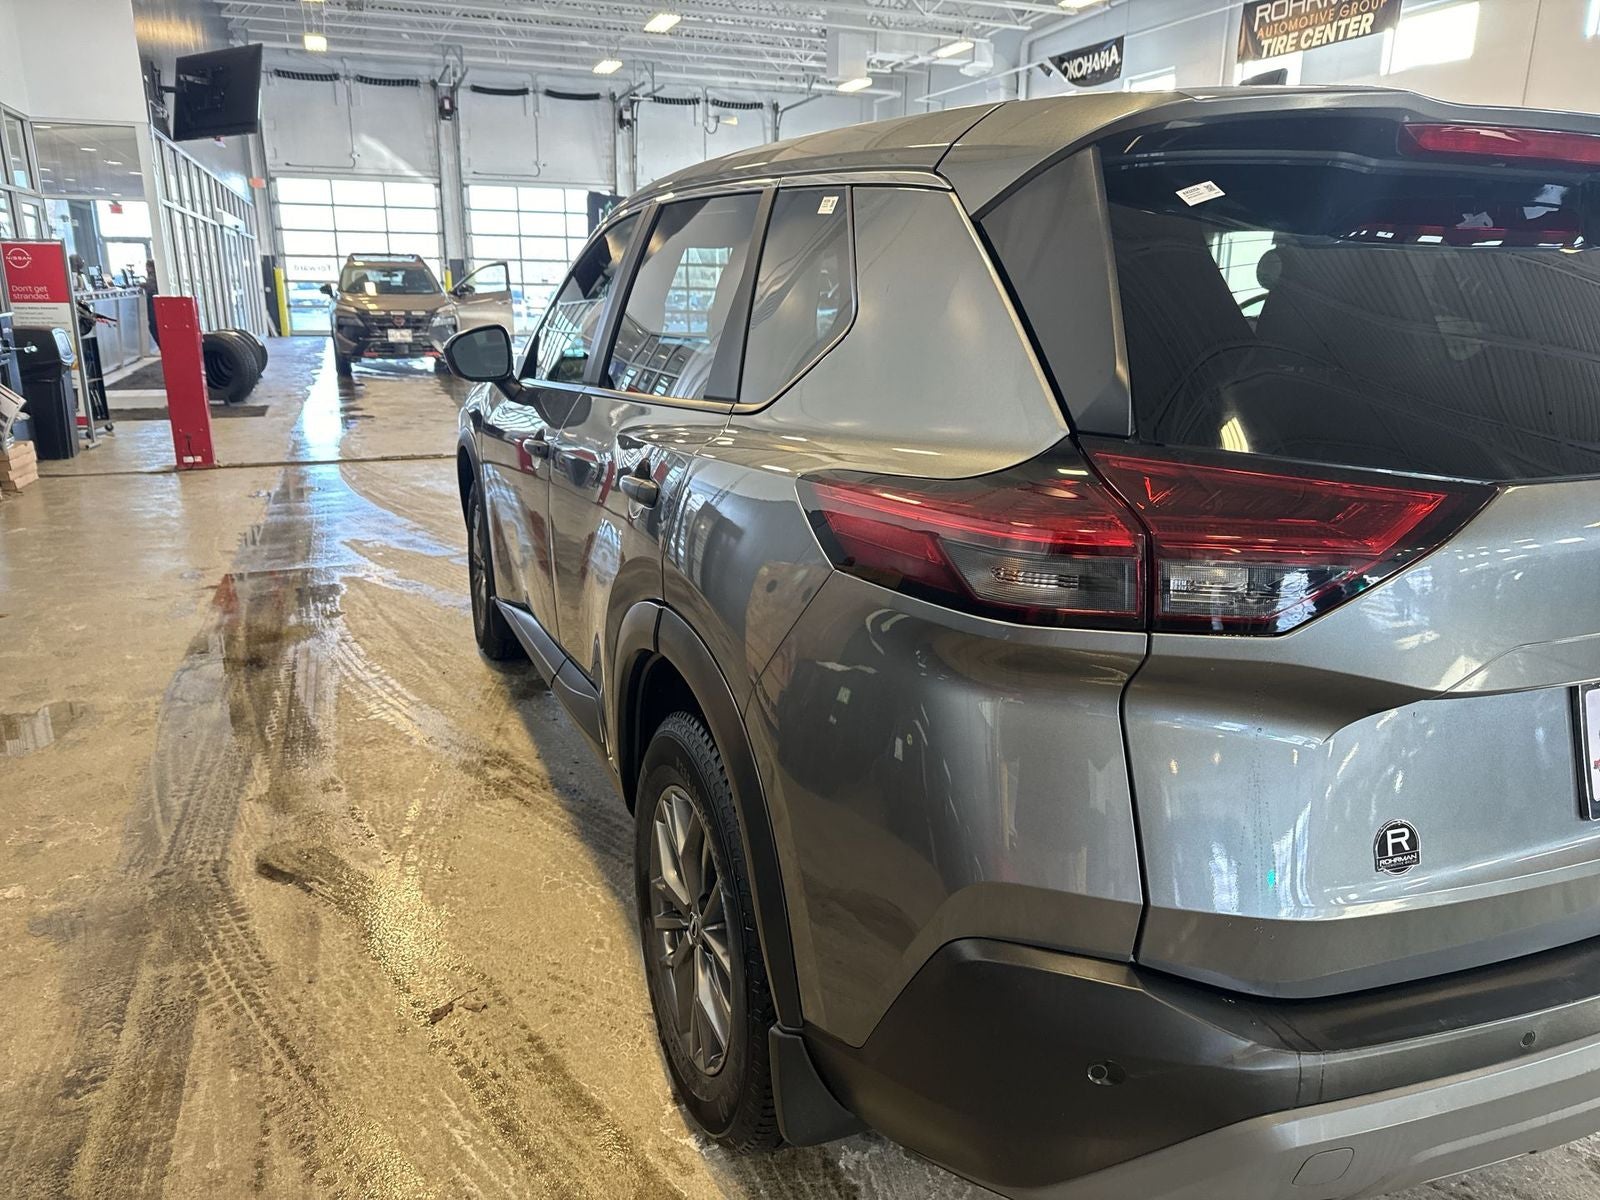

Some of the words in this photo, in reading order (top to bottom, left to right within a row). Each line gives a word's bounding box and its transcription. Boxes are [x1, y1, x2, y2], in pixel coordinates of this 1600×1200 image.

[1257, 8, 1335, 40] AUTOMOTIVE
[1261, 31, 1299, 58] TIRE
[1300, 12, 1375, 49] CENTER
[1386, 827, 1411, 857] R
[1380, 853, 1418, 867] ROHRMAN
